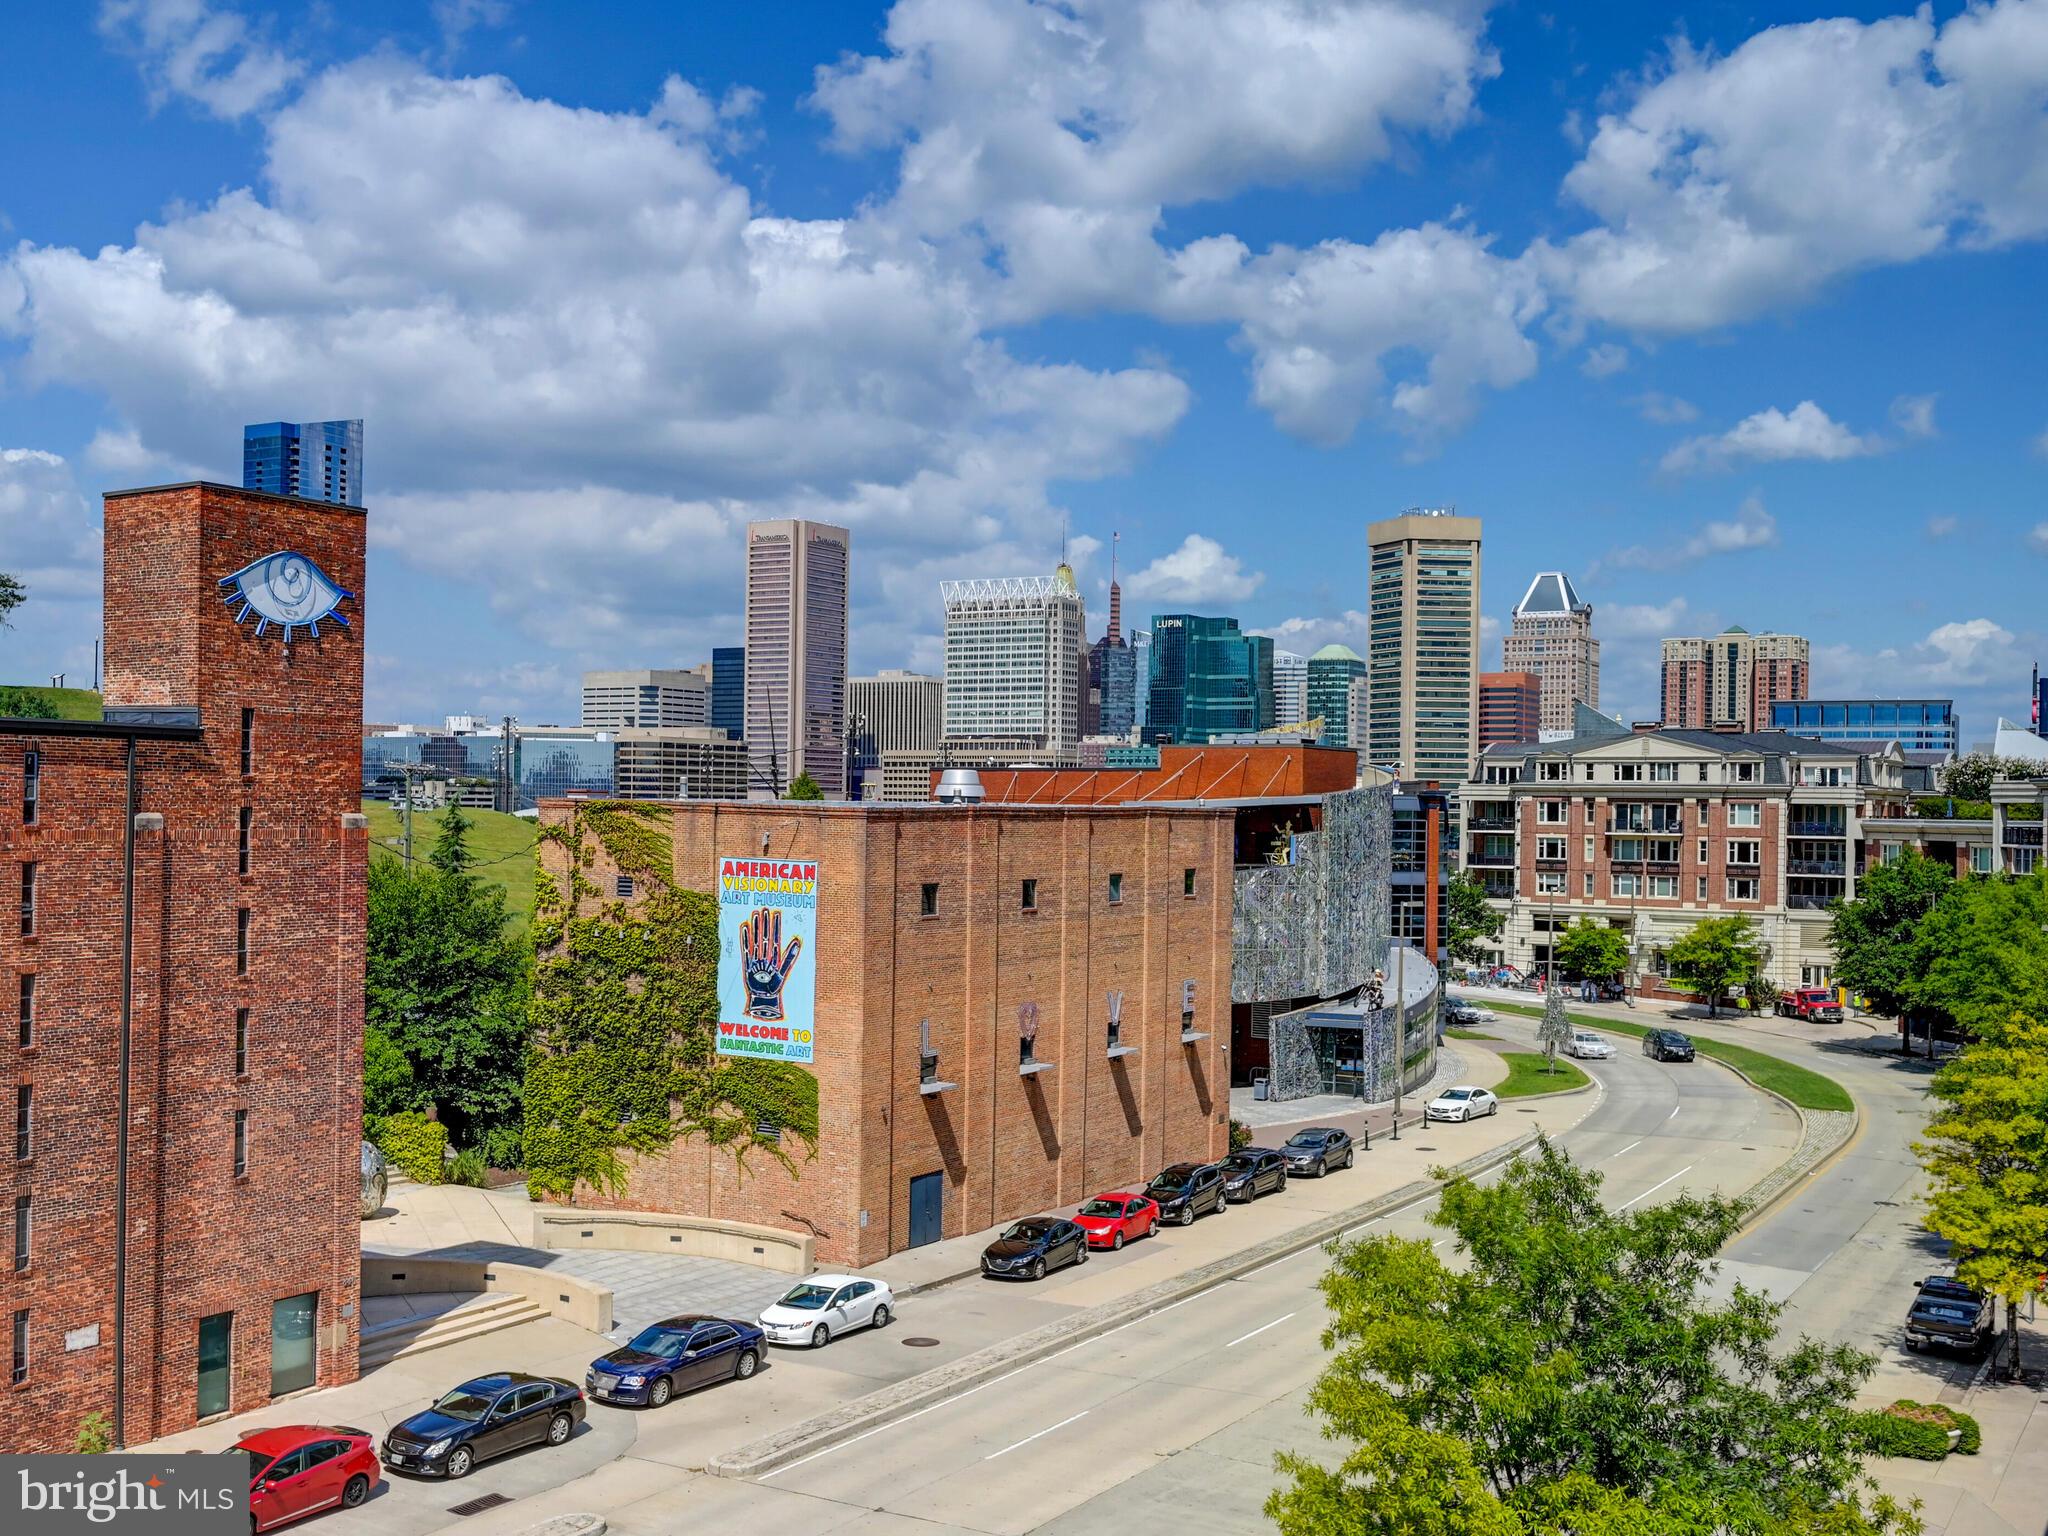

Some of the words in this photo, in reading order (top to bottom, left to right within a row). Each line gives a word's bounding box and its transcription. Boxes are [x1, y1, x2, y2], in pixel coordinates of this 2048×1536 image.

[755, 534, 790, 542] TRANSAMERICA
[1156, 619, 1183, 628] LUPIN
[722, 861, 816, 880] AMERICAN
[722, 876, 815, 894] VISIONARY
[720, 890, 751, 905] ART
[753, 892, 816, 909] MUSEUM
[719, 1021, 789, 1041] WELCOME
[792, 1028, 812, 1043] TO
[719, 1037, 784, 1055] FANTASTIC
[785, 1044, 812, 1058] ART
